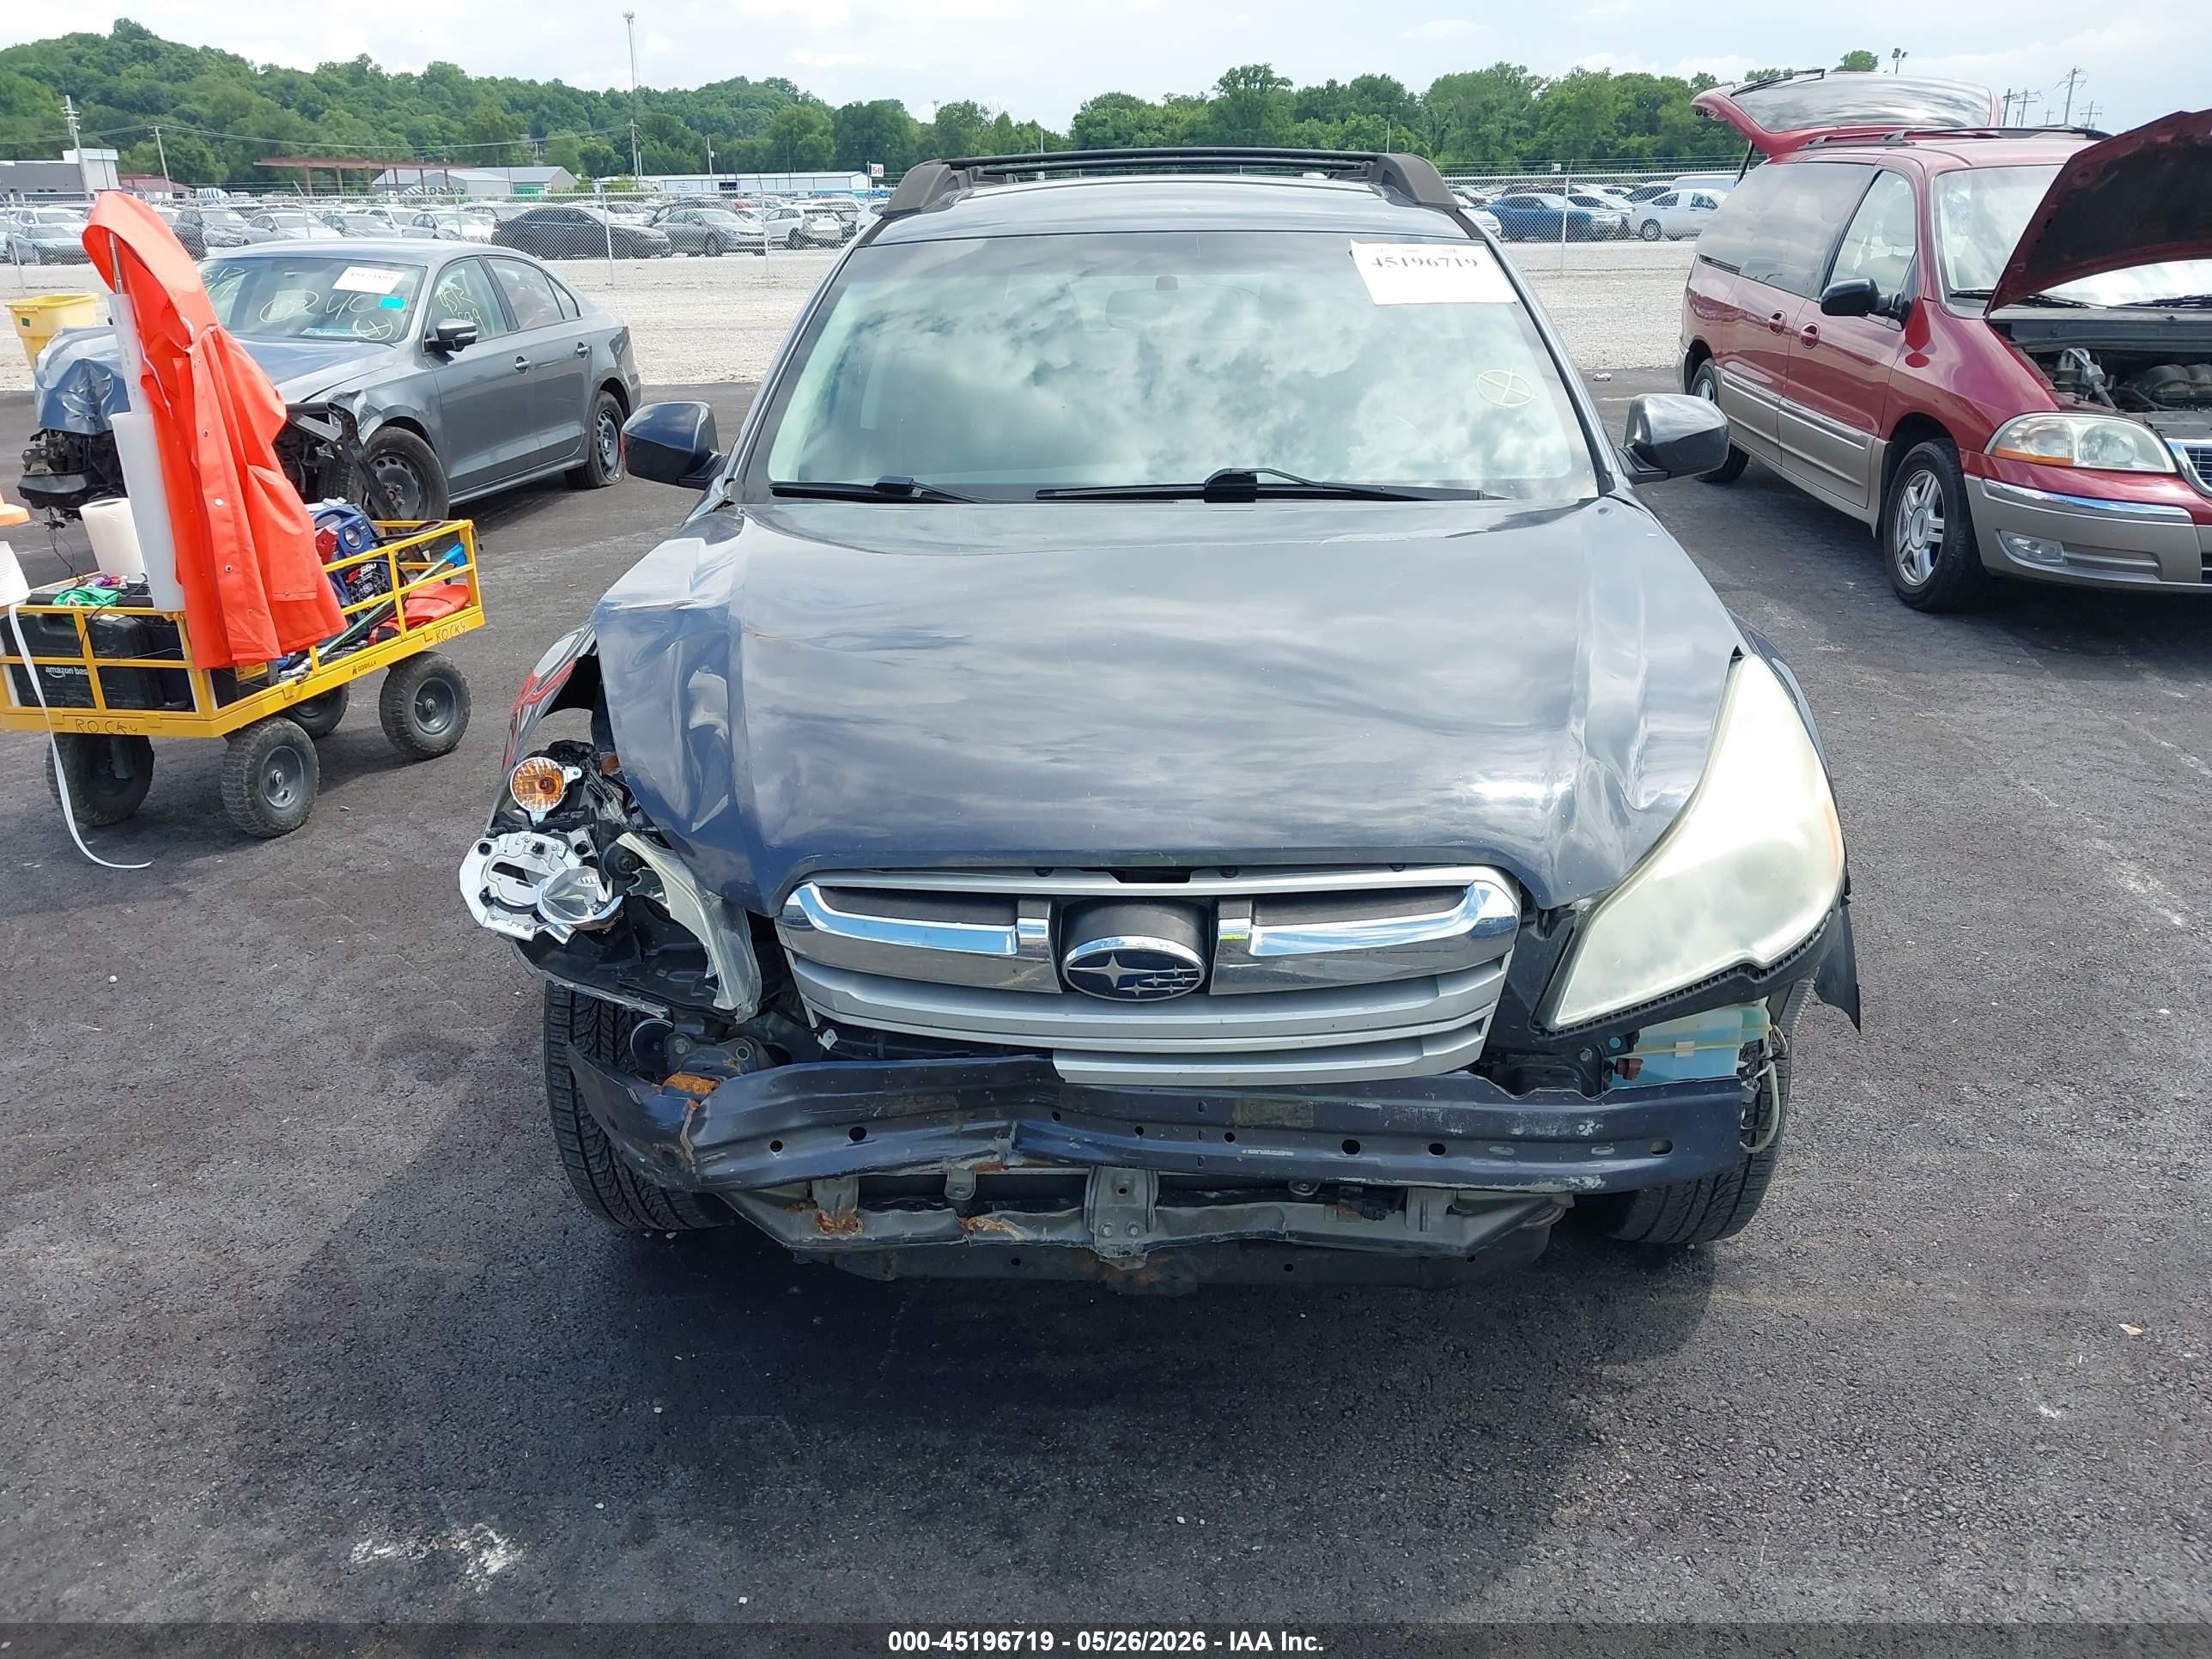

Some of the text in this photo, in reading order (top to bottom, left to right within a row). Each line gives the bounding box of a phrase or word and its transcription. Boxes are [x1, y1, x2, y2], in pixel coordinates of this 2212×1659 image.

[1371, 257, 1478, 268] 45196719
[45, 666, 74, 676] amazon
[357, 659, 377, 672] GORILLA
